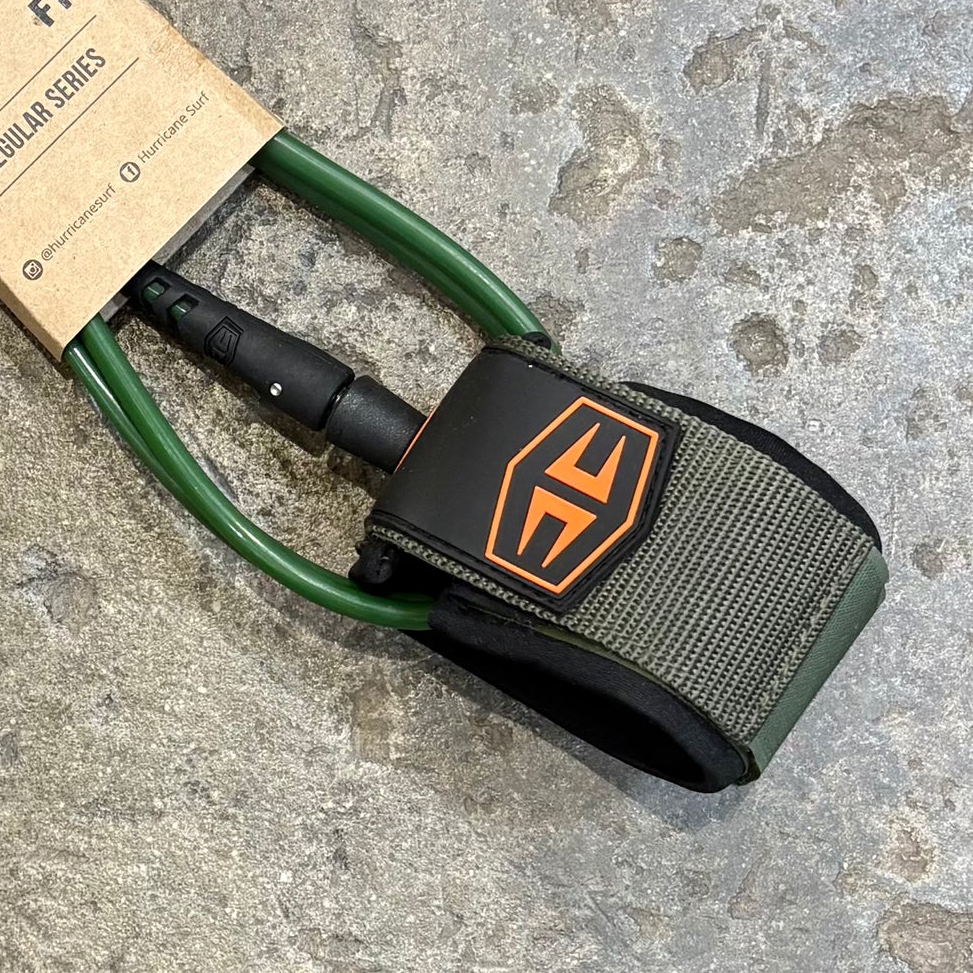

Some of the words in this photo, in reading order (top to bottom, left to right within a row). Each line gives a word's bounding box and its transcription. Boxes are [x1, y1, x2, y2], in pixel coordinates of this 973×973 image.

[45, 48, 107, 109] SERIES
[138, 113, 189, 163] Hurricane
[187, 91, 210, 116] Surf
[40, 183, 116, 261] @hurricanesurf
